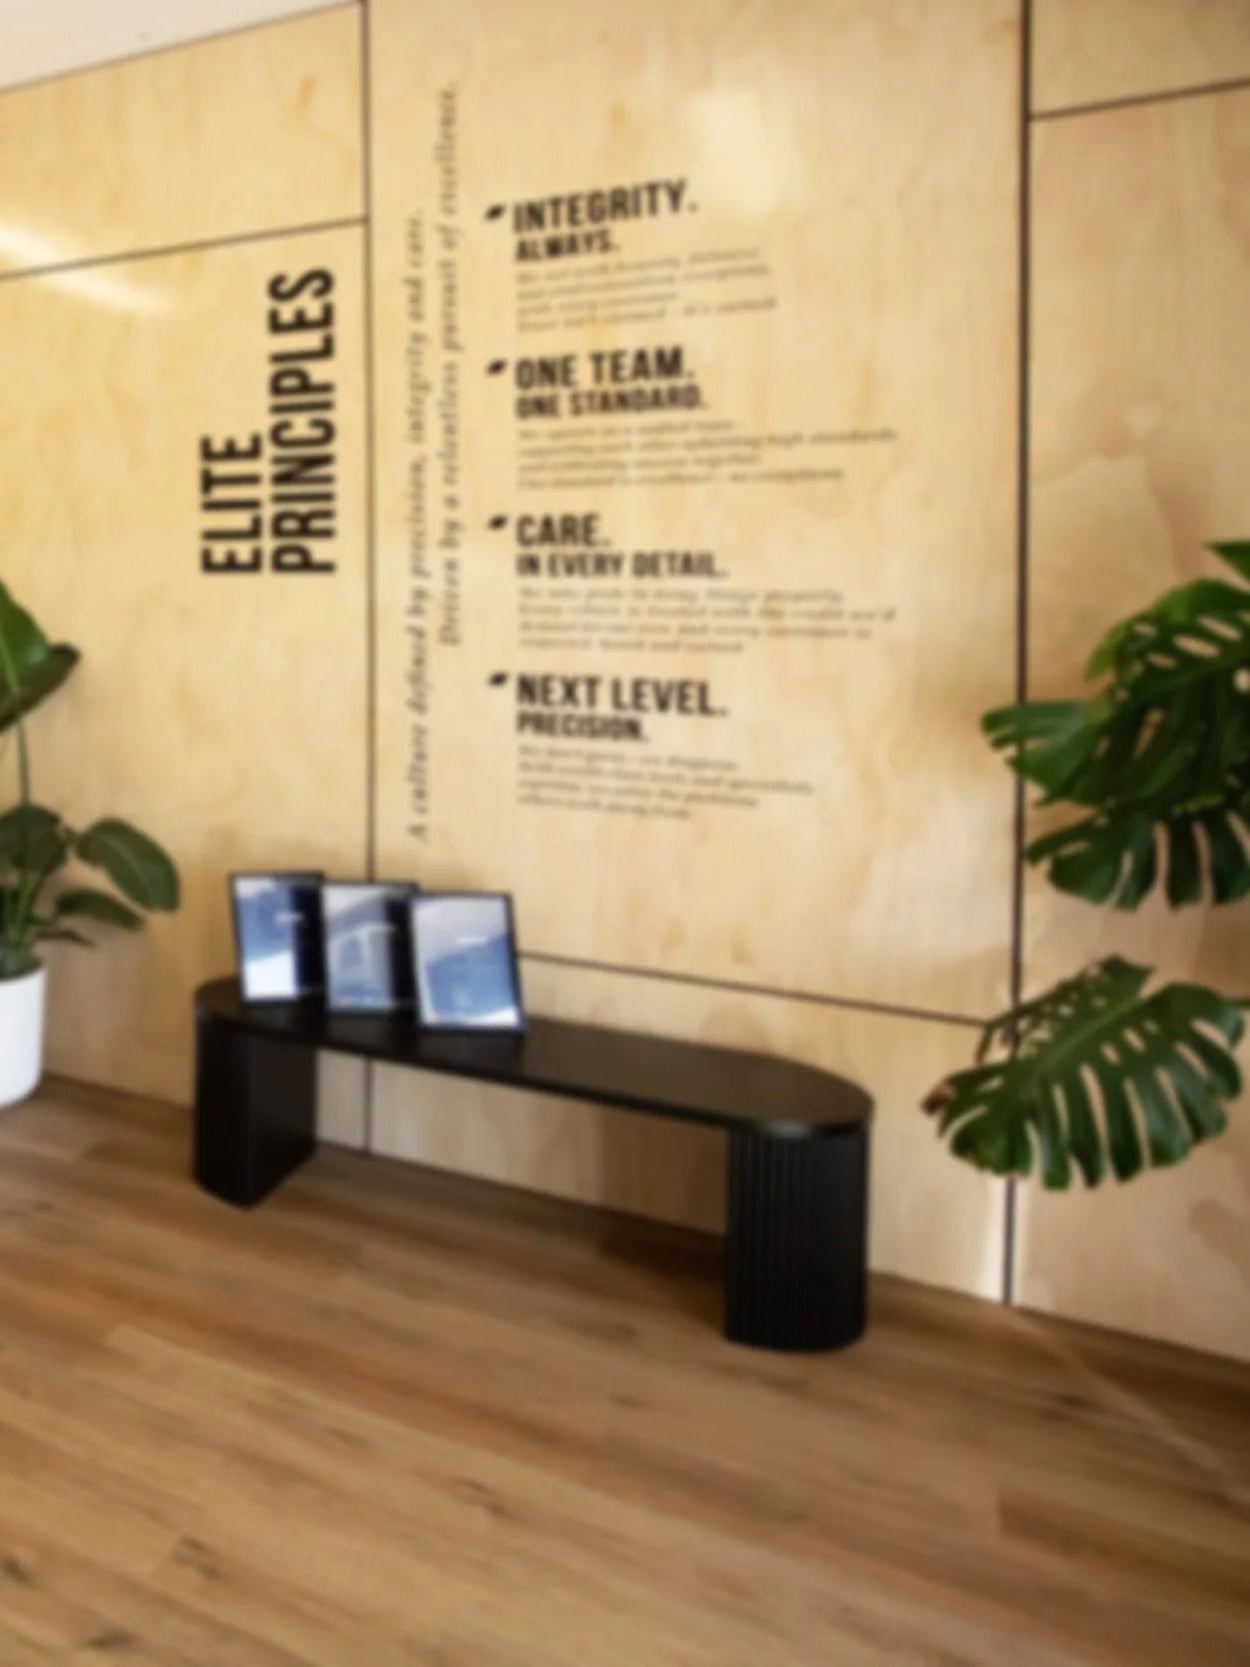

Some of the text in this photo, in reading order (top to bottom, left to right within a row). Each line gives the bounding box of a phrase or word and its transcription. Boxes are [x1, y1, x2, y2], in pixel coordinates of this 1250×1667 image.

[513, 177, 698, 234] INTEGRITY.
[434, 224, 465, 252] of
[514, 228, 620, 262] ALWAYS.
[400, 276, 425, 324] and
[435, 260, 465, 354] pursuit
[403, 333, 432, 445] integrity
[515, 345, 695, 391] ONE TEAM.
[267, 267, 336, 574] PRINCIPLES
[436, 361, 460, 487] relentless
[515, 383, 708, 421] ONE STANDARD.
[201, 432, 263, 574] ELITE
[436, 521, 466, 551] by
[516, 512, 611, 547] CARE.
[516, 551, 729, 579] IN EVERY DETAIL.
[404, 589, 432, 619] by
[438, 558, 462, 647] Driven
[404, 625, 434, 717] defined
[516, 673, 729, 718] NEXT LEVEL.
[516, 710, 650, 744] PRECISION.
[406, 722, 429, 817] culture
